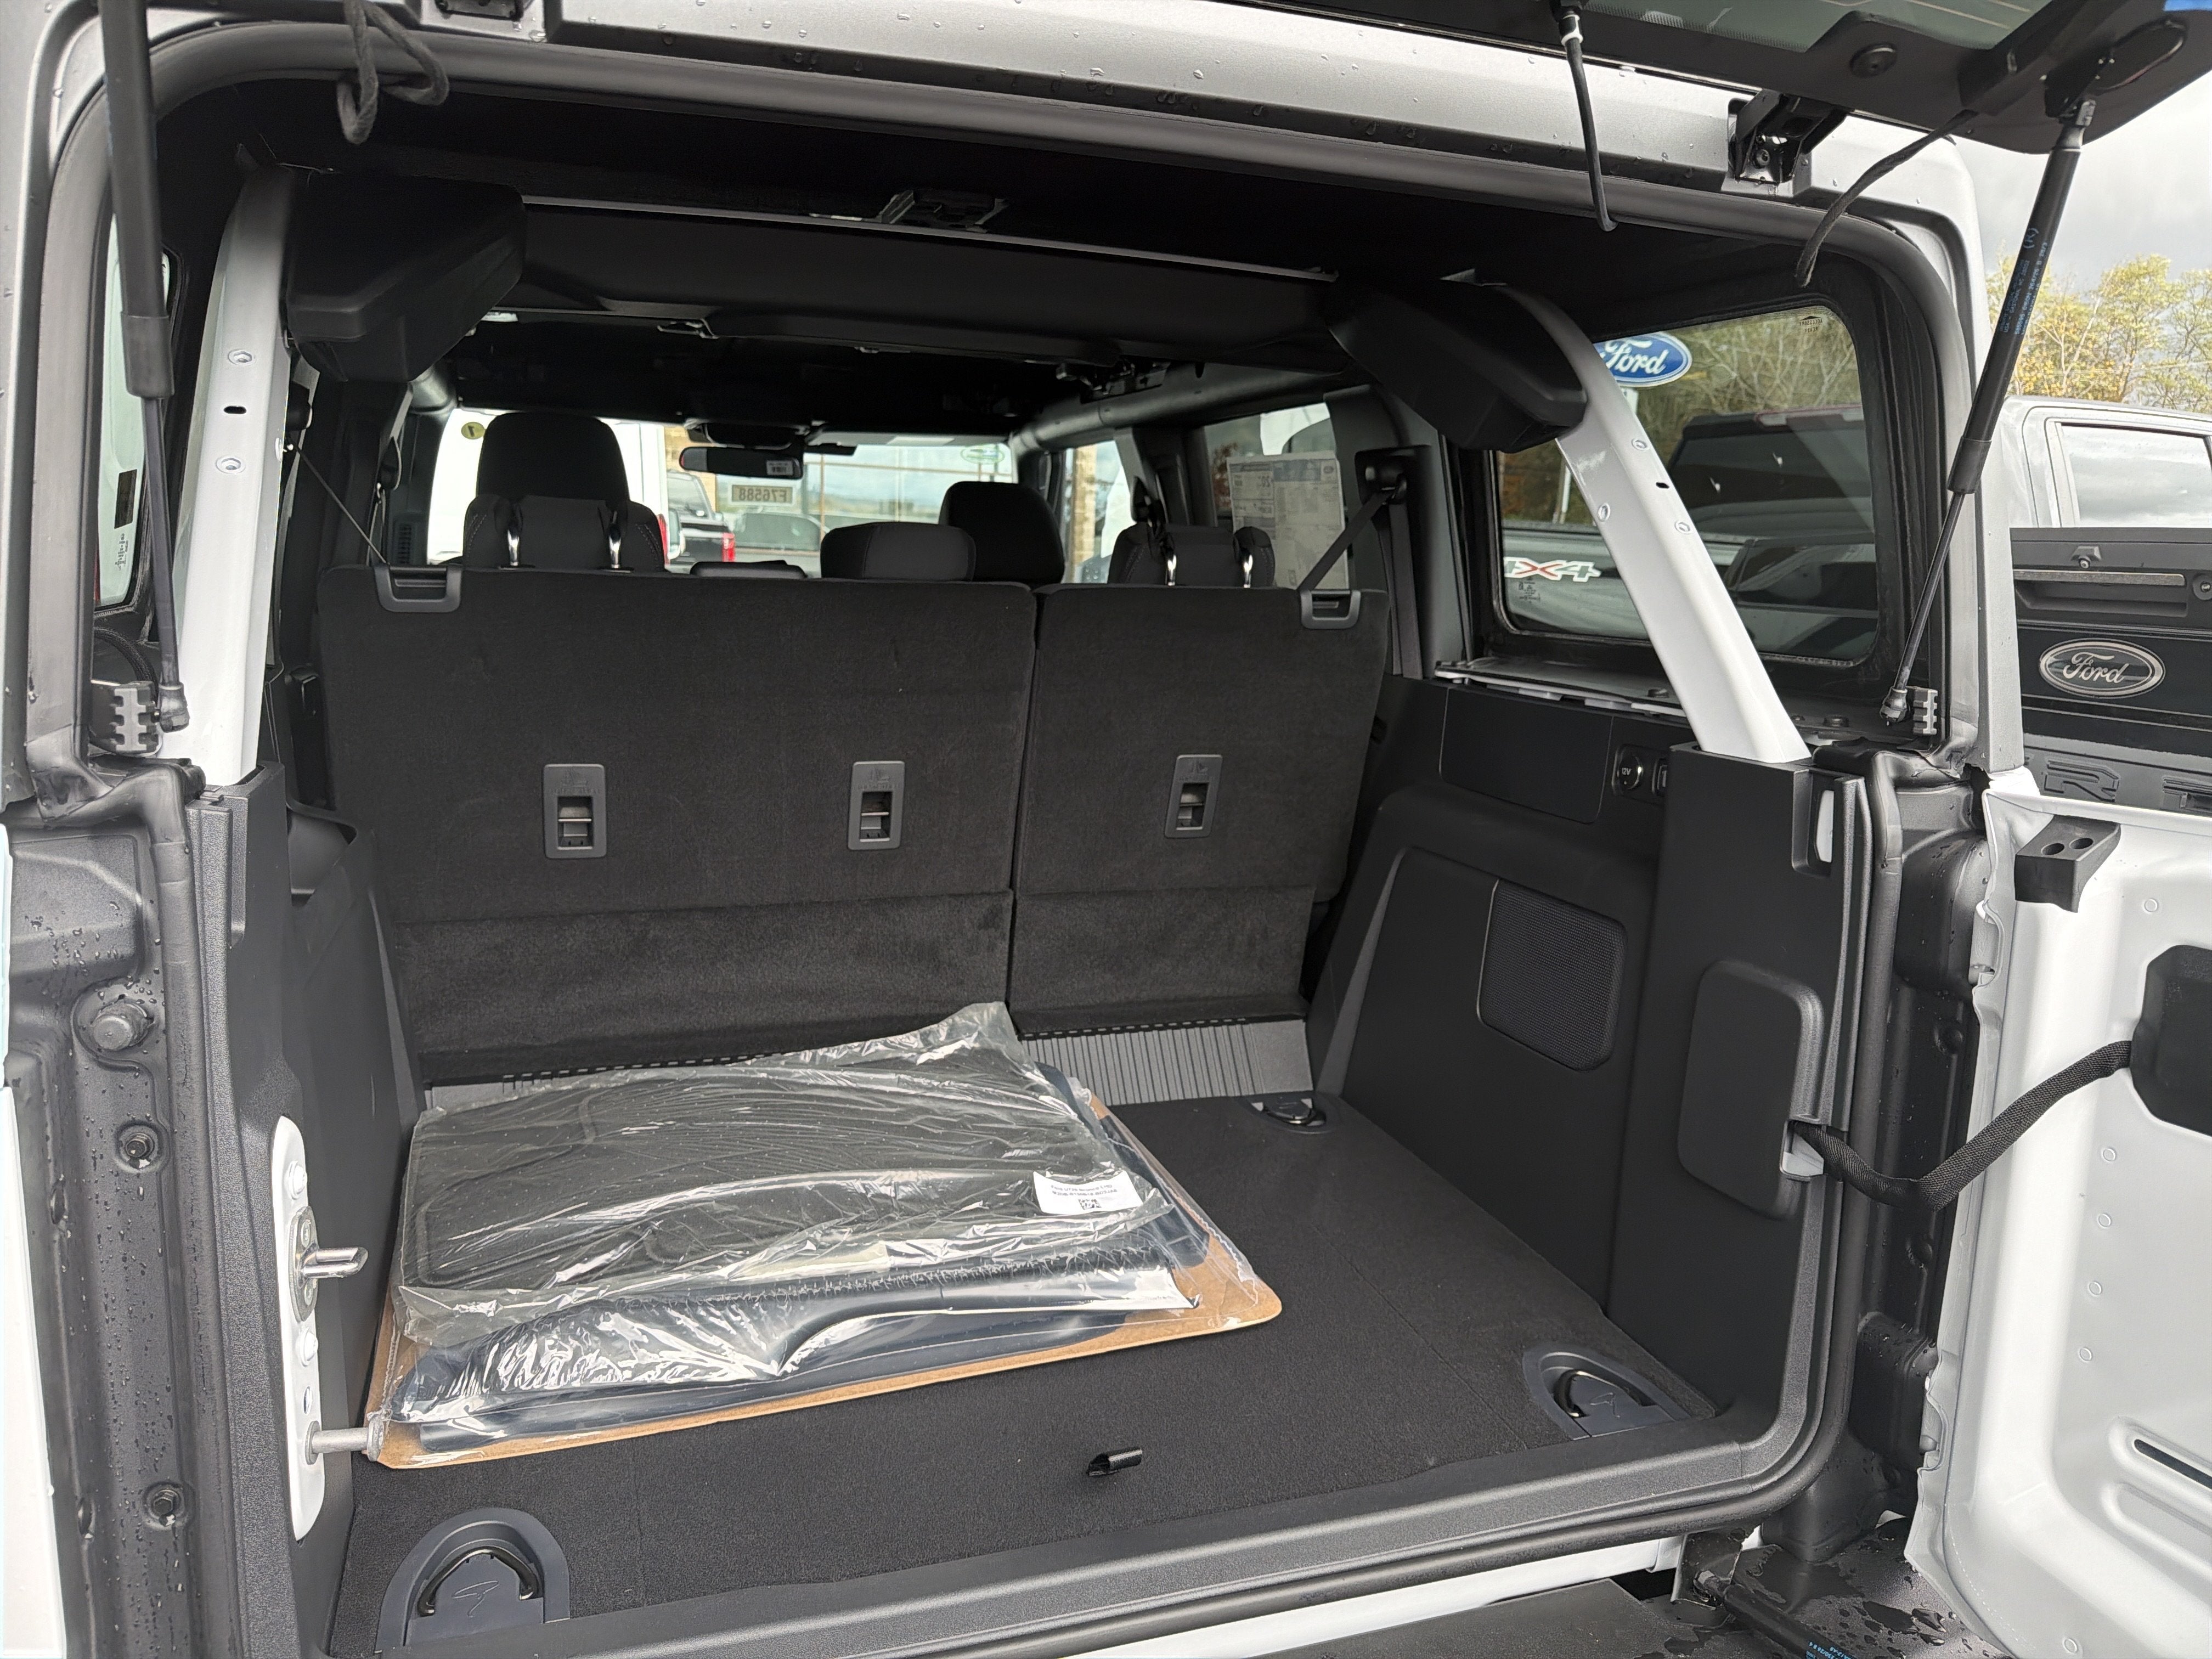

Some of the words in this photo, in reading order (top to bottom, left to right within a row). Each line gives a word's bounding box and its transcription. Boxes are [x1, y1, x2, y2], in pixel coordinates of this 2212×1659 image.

[1600, 339, 1669, 374] Ford
[2063, 651, 2130, 684] Ford
[1622, 767, 1632, 776] 12V
